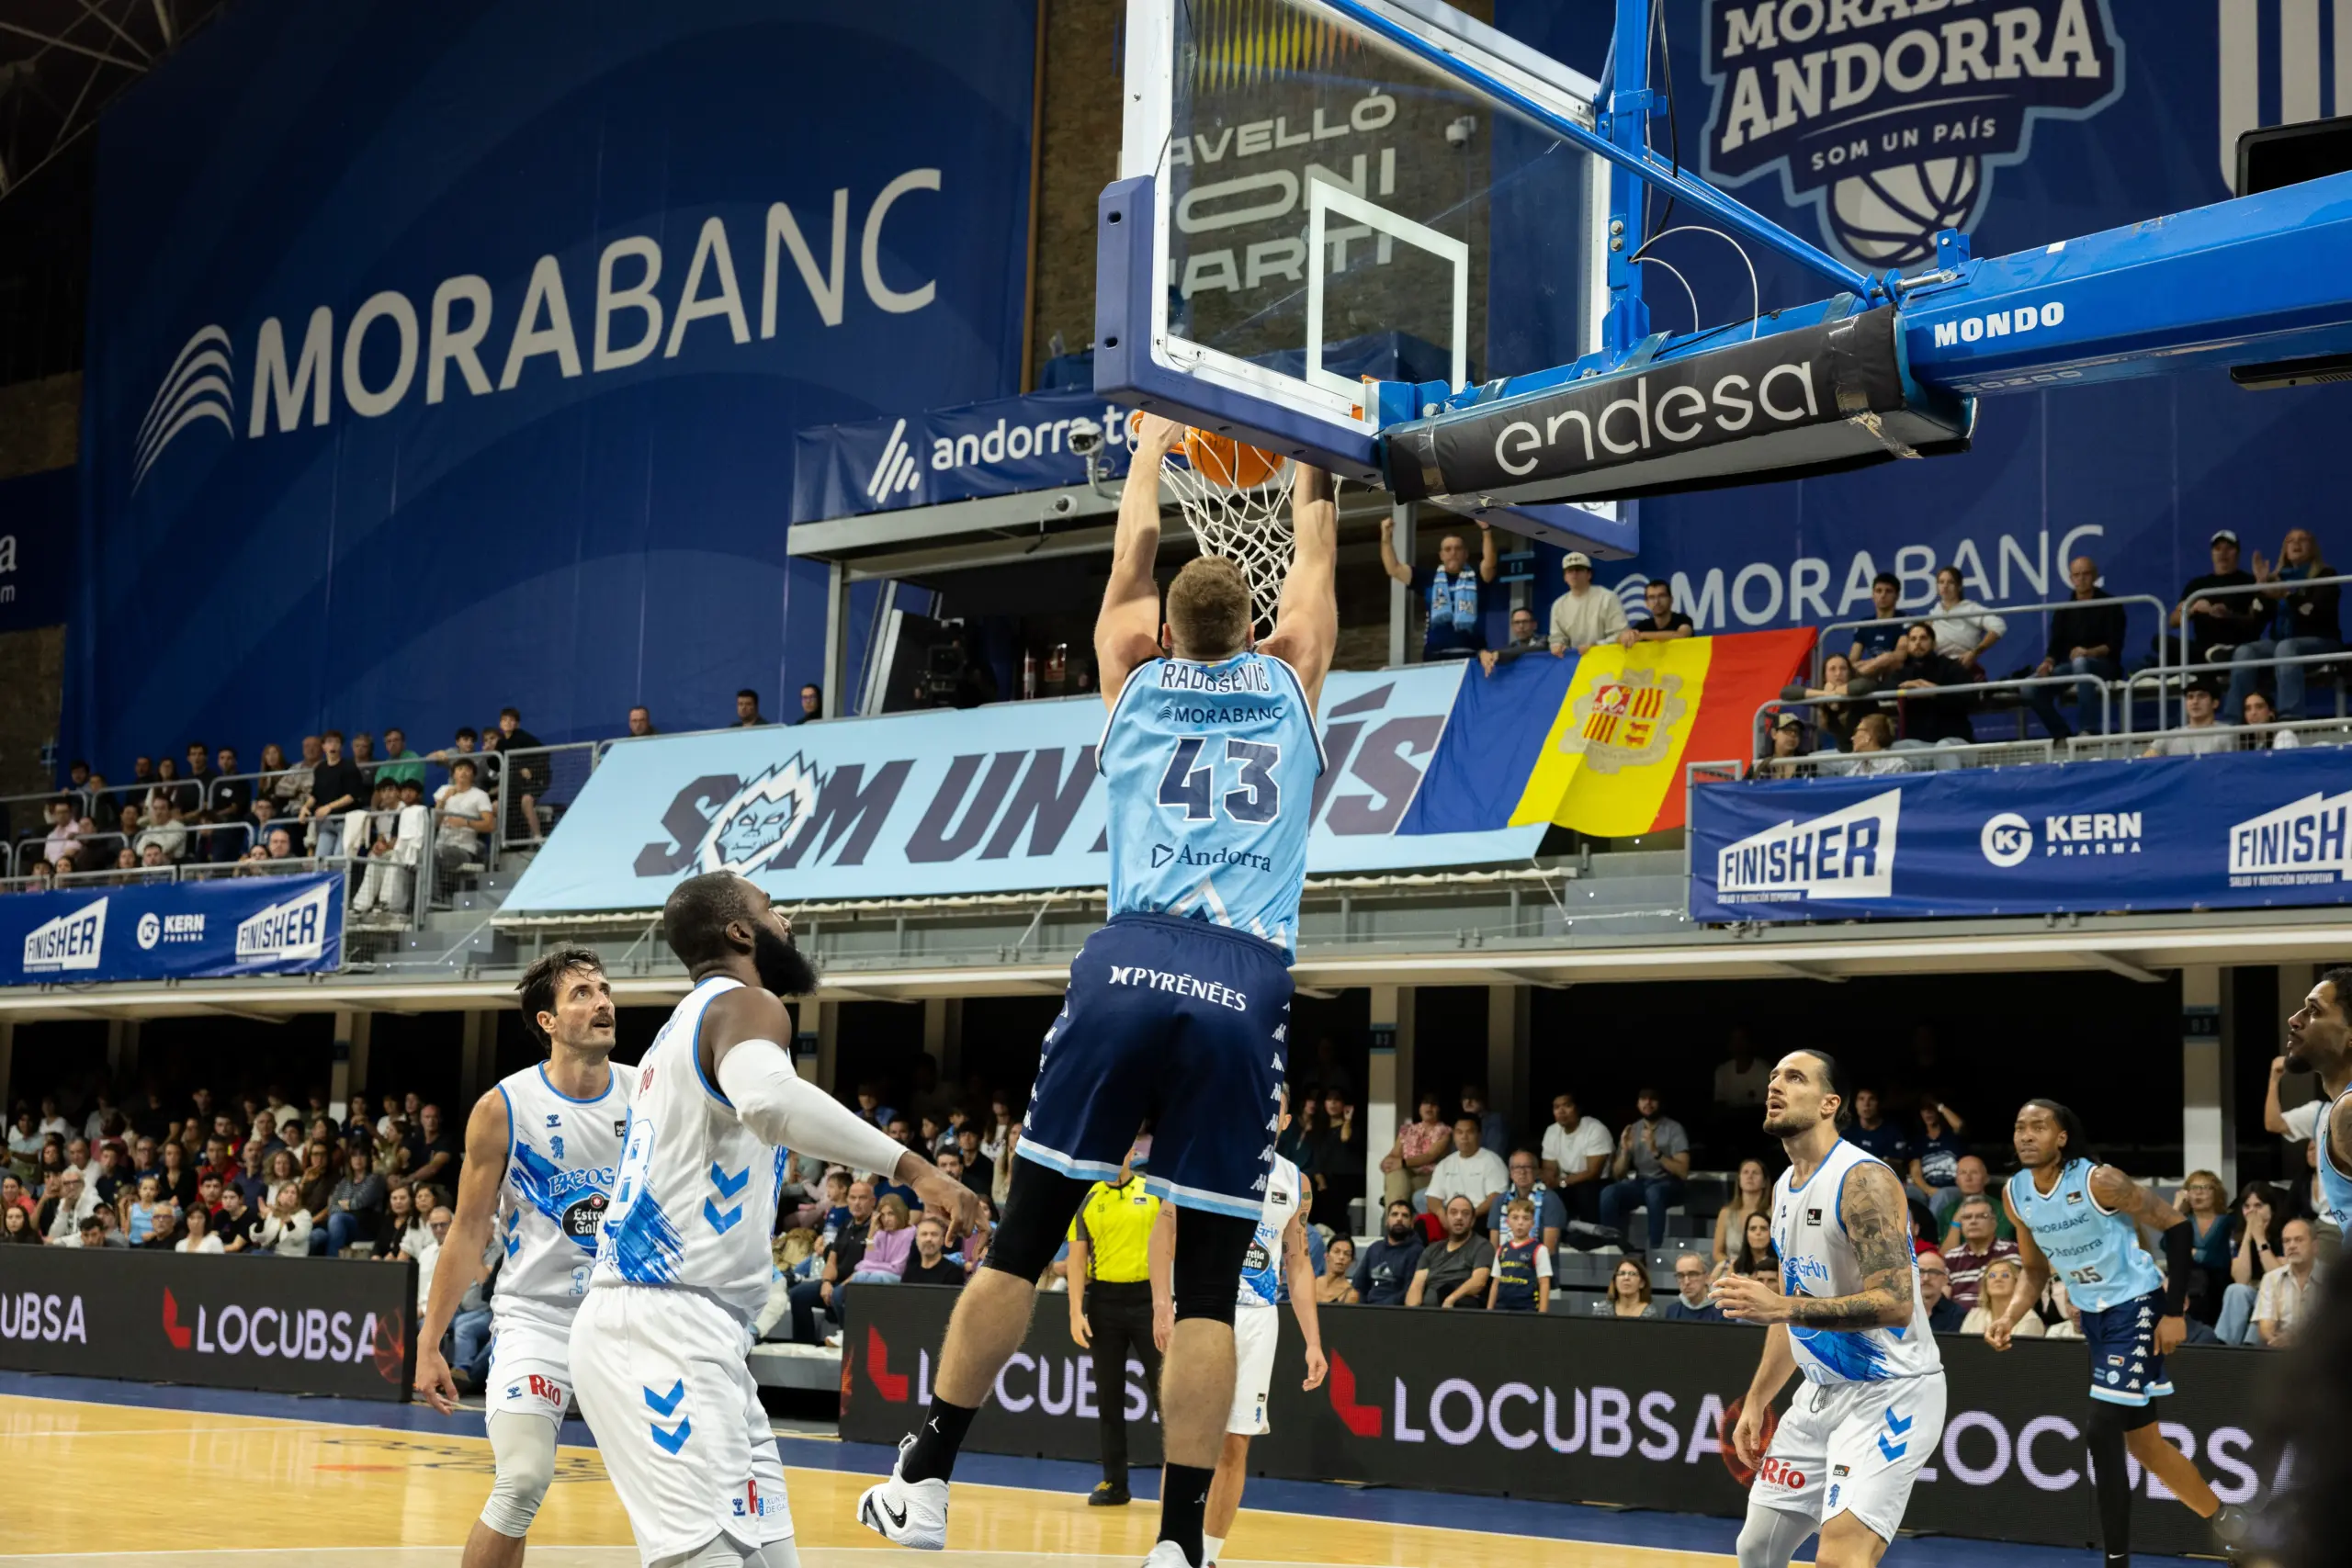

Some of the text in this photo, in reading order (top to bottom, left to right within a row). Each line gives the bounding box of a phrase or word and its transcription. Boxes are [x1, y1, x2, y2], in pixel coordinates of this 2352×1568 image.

[1721, 0, 2100, 154] ANDORRA
[1169, 86, 1397, 167] AVELLÓ
[1811, 115, 1997, 172] SOM UN PAÍS
[1170, 147, 1396, 234] ONI
[248, 168, 943, 438] MORABANC
[1934, 301, 2065, 349] MONDO
[1494, 361, 1820, 477] endesa
[1670, 525, 2104, 630] MORABANC
[1174, 705, 1284, 724] MORABANC
[1156, 735, 1282, 826] 43
[1724, 816, 1882, 887] FINISHER
[2045, 812, 2143, 842] KERN
[2047, 841, 2142, 857] PHARMA
[1176, 843, 1272, 873] Andorra
[27, 915, 99, 962] FINISHER
[163, 932, 204, 942] PHARMA
[164, 914, 206, 933] KERN
[239, 902, 319, 951] FINISHER
[2055, 1238, 2104, 1258] Andorra
[2070, 1266, 2104, 1284] 25
[196, 1303, 378, 1364] LOCUBSA
[1393, 1375, 1727, 1464] LOCUBSA
[1760, 1457, 1805, 1490] Río
